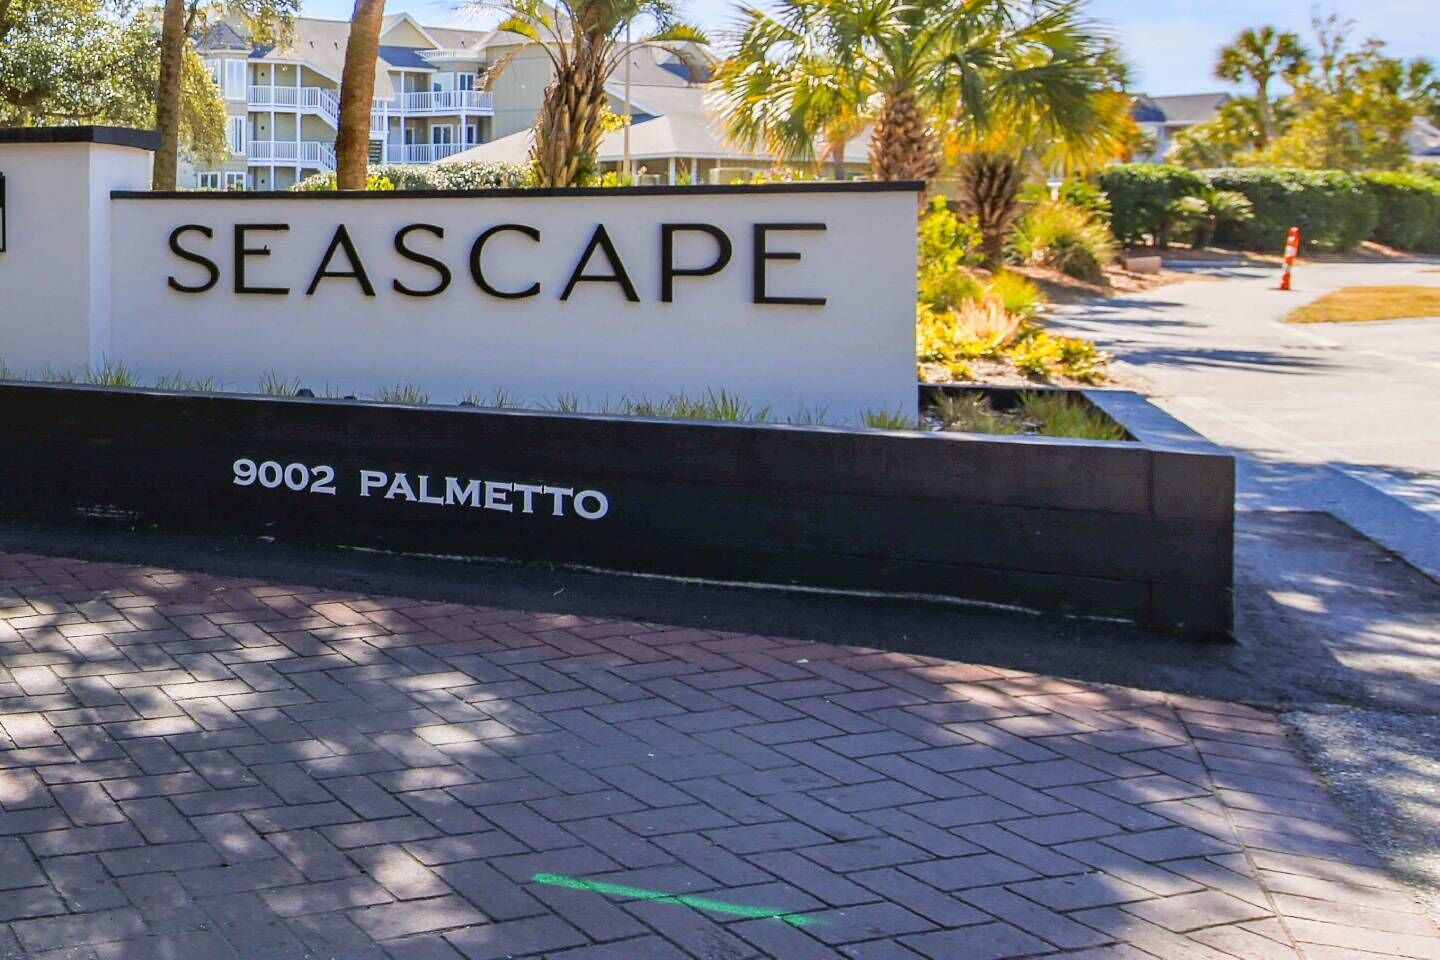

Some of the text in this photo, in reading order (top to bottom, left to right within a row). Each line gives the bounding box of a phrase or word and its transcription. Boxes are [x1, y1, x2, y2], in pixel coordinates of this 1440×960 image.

[167, 223, 828, 306] SEASCAPE
[232, 458, 609, 520] 9002 PALMETTO
